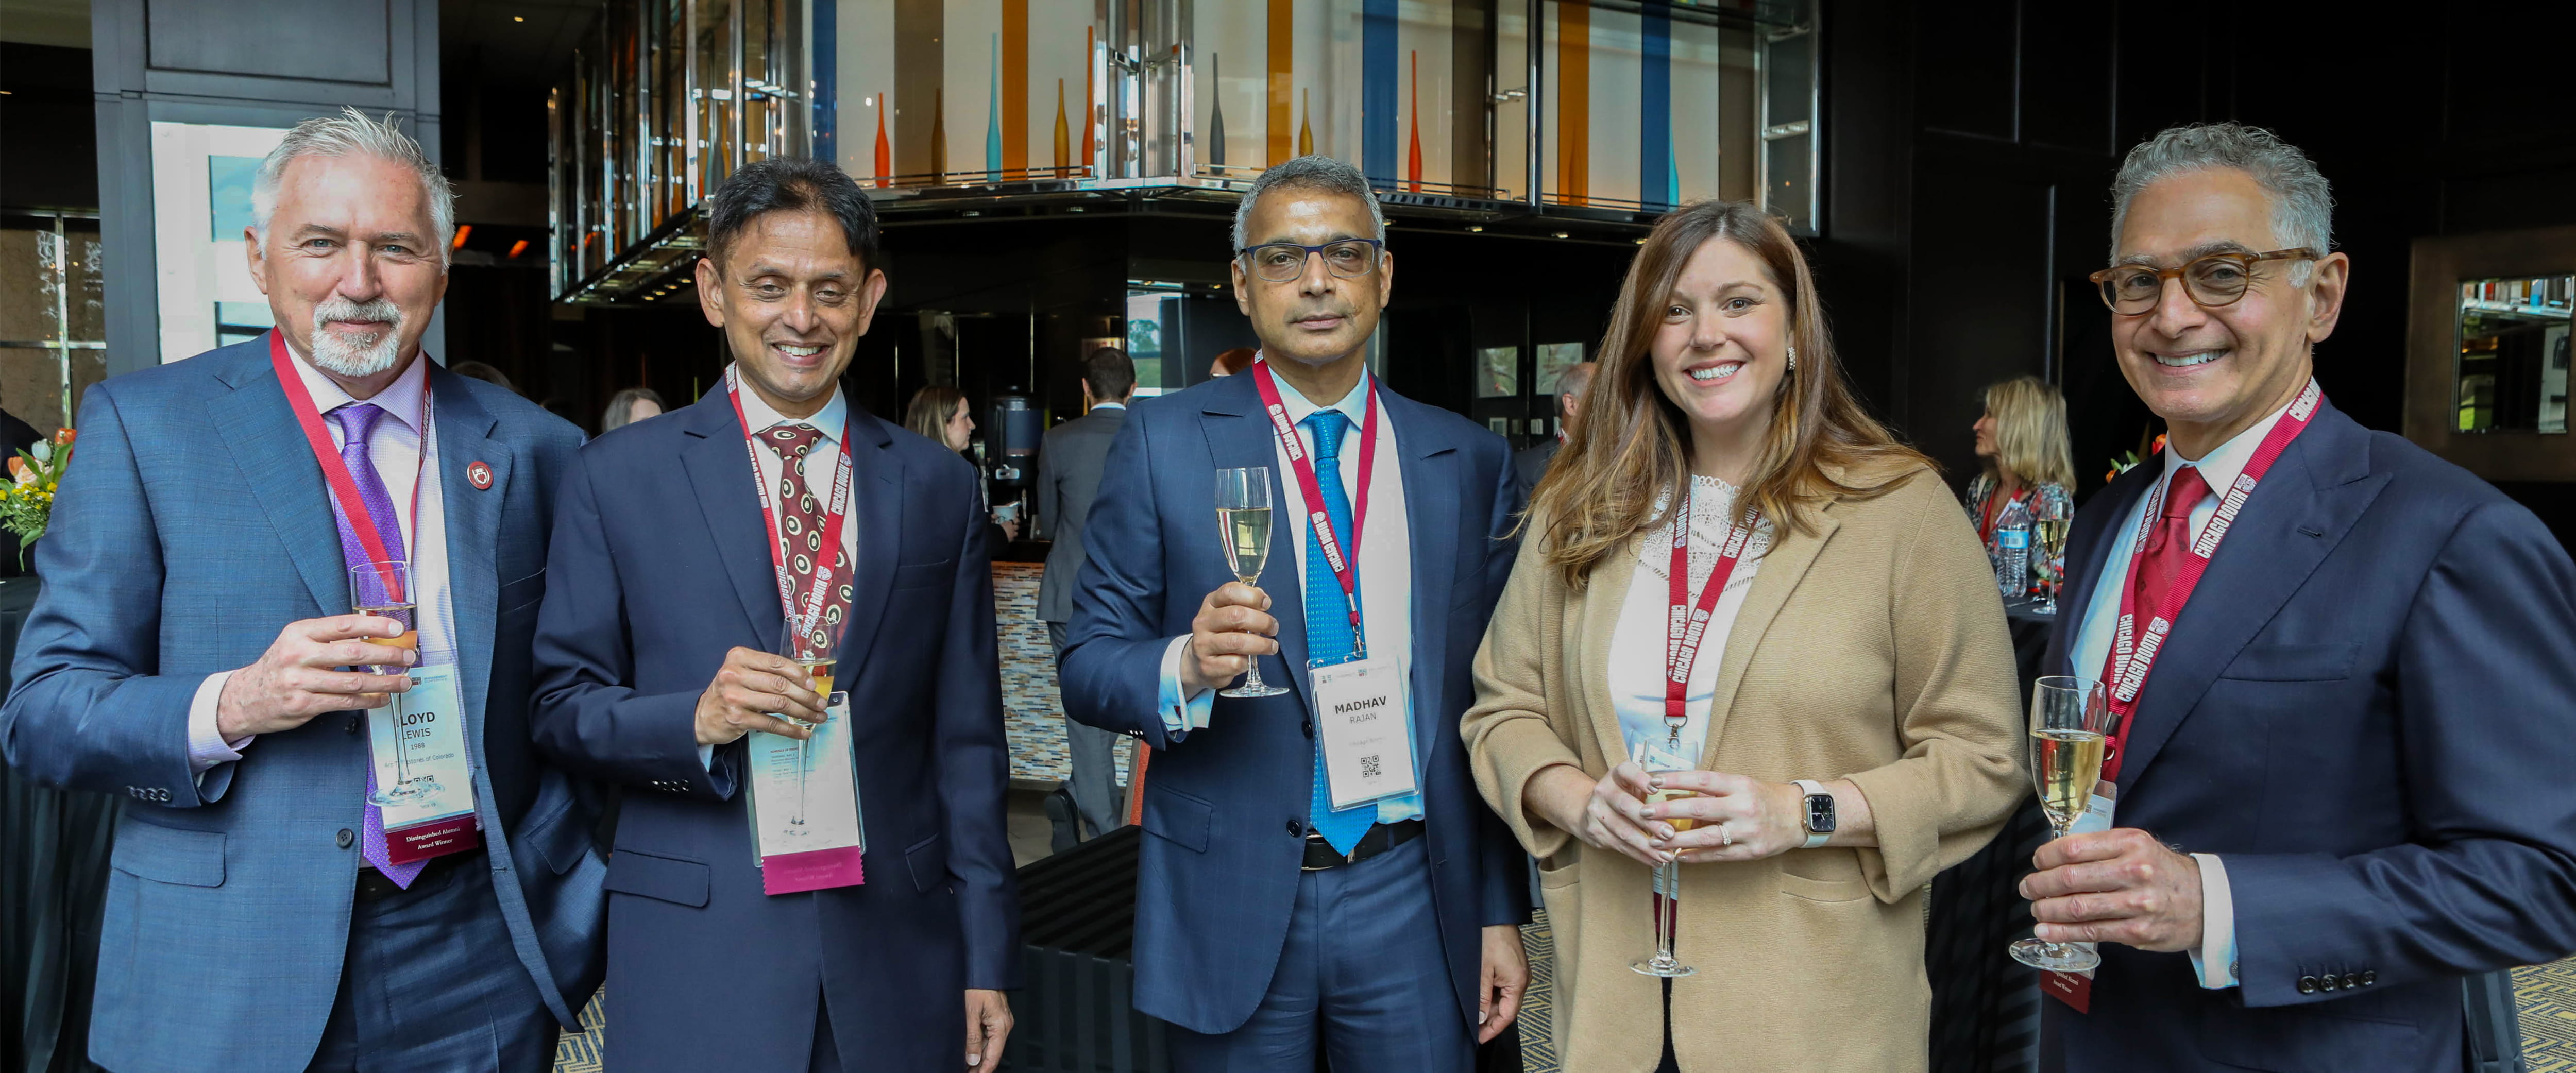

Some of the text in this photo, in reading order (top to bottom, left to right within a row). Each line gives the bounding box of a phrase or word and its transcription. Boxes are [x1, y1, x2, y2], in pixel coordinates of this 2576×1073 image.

[2289, 387, 2319, 422] CHICAGO
[1273, 413, 1303, 461] CHICAGO BOOTH
[831, 463, 850, 516] CHICAGO BOOTH
[1722, 526, 1749, 558] CHICAGO
[2194, 488, 2249, 559] CHICAGO BOOTH
[1315, 520, 1345, 572] CHICAGO BOOTH
[776, 565, 790, 600] CHICAGO
[801, 578, 828, 639] CHICAGO BOOTH
[1670, 605, 1687, 639] CHICAGO
[1672, 621, 1705, 684] CHICAGO BOOTH
[2116, 614, 2133, 654] CHICAGO
[2115, 631, 2162, 702] CHICAGO BOOTH
[1335, 695, 1386, 714] MADHAV
[1350, 713, 1376, 724] RAJAN
[406, 826, 461, 842] Distinguished Alumni
[418, 838, 453, 850] Award Winner
